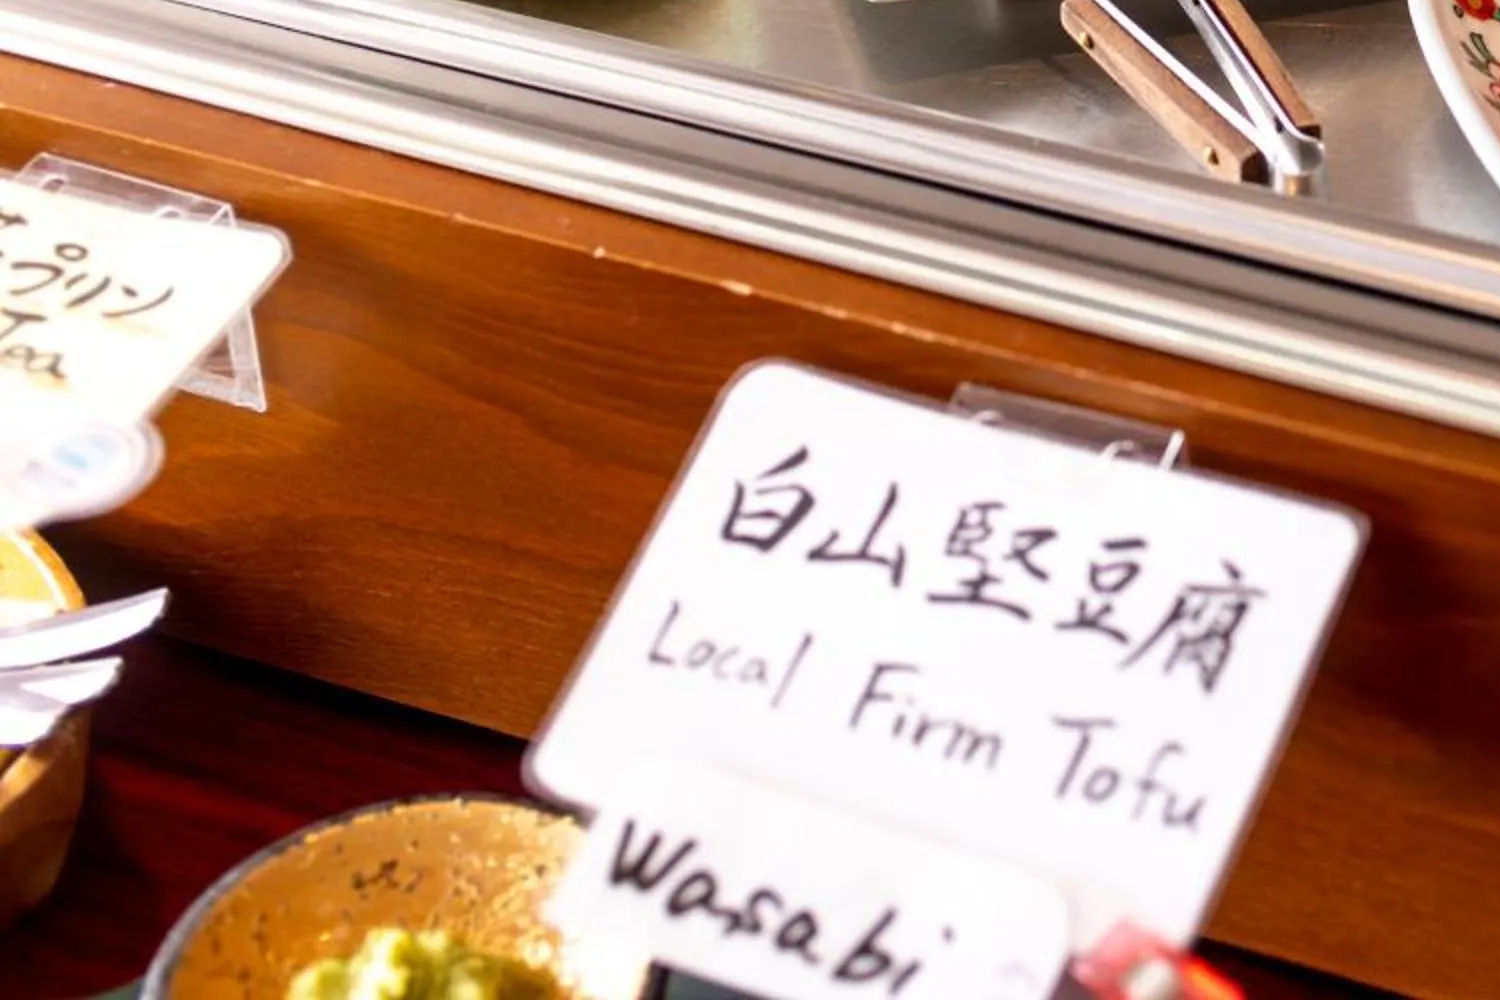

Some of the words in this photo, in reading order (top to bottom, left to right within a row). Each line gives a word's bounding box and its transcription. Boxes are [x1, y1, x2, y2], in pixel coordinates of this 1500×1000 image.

[720, 446, 1268, 694] 白山堅豆腐
[648, 600, 813, 708] Local
[848, 662, 1003, 768] Firm
[1051, 713, 1207, 832] Tofu
[608, 818, 956, 996] Wasabi
